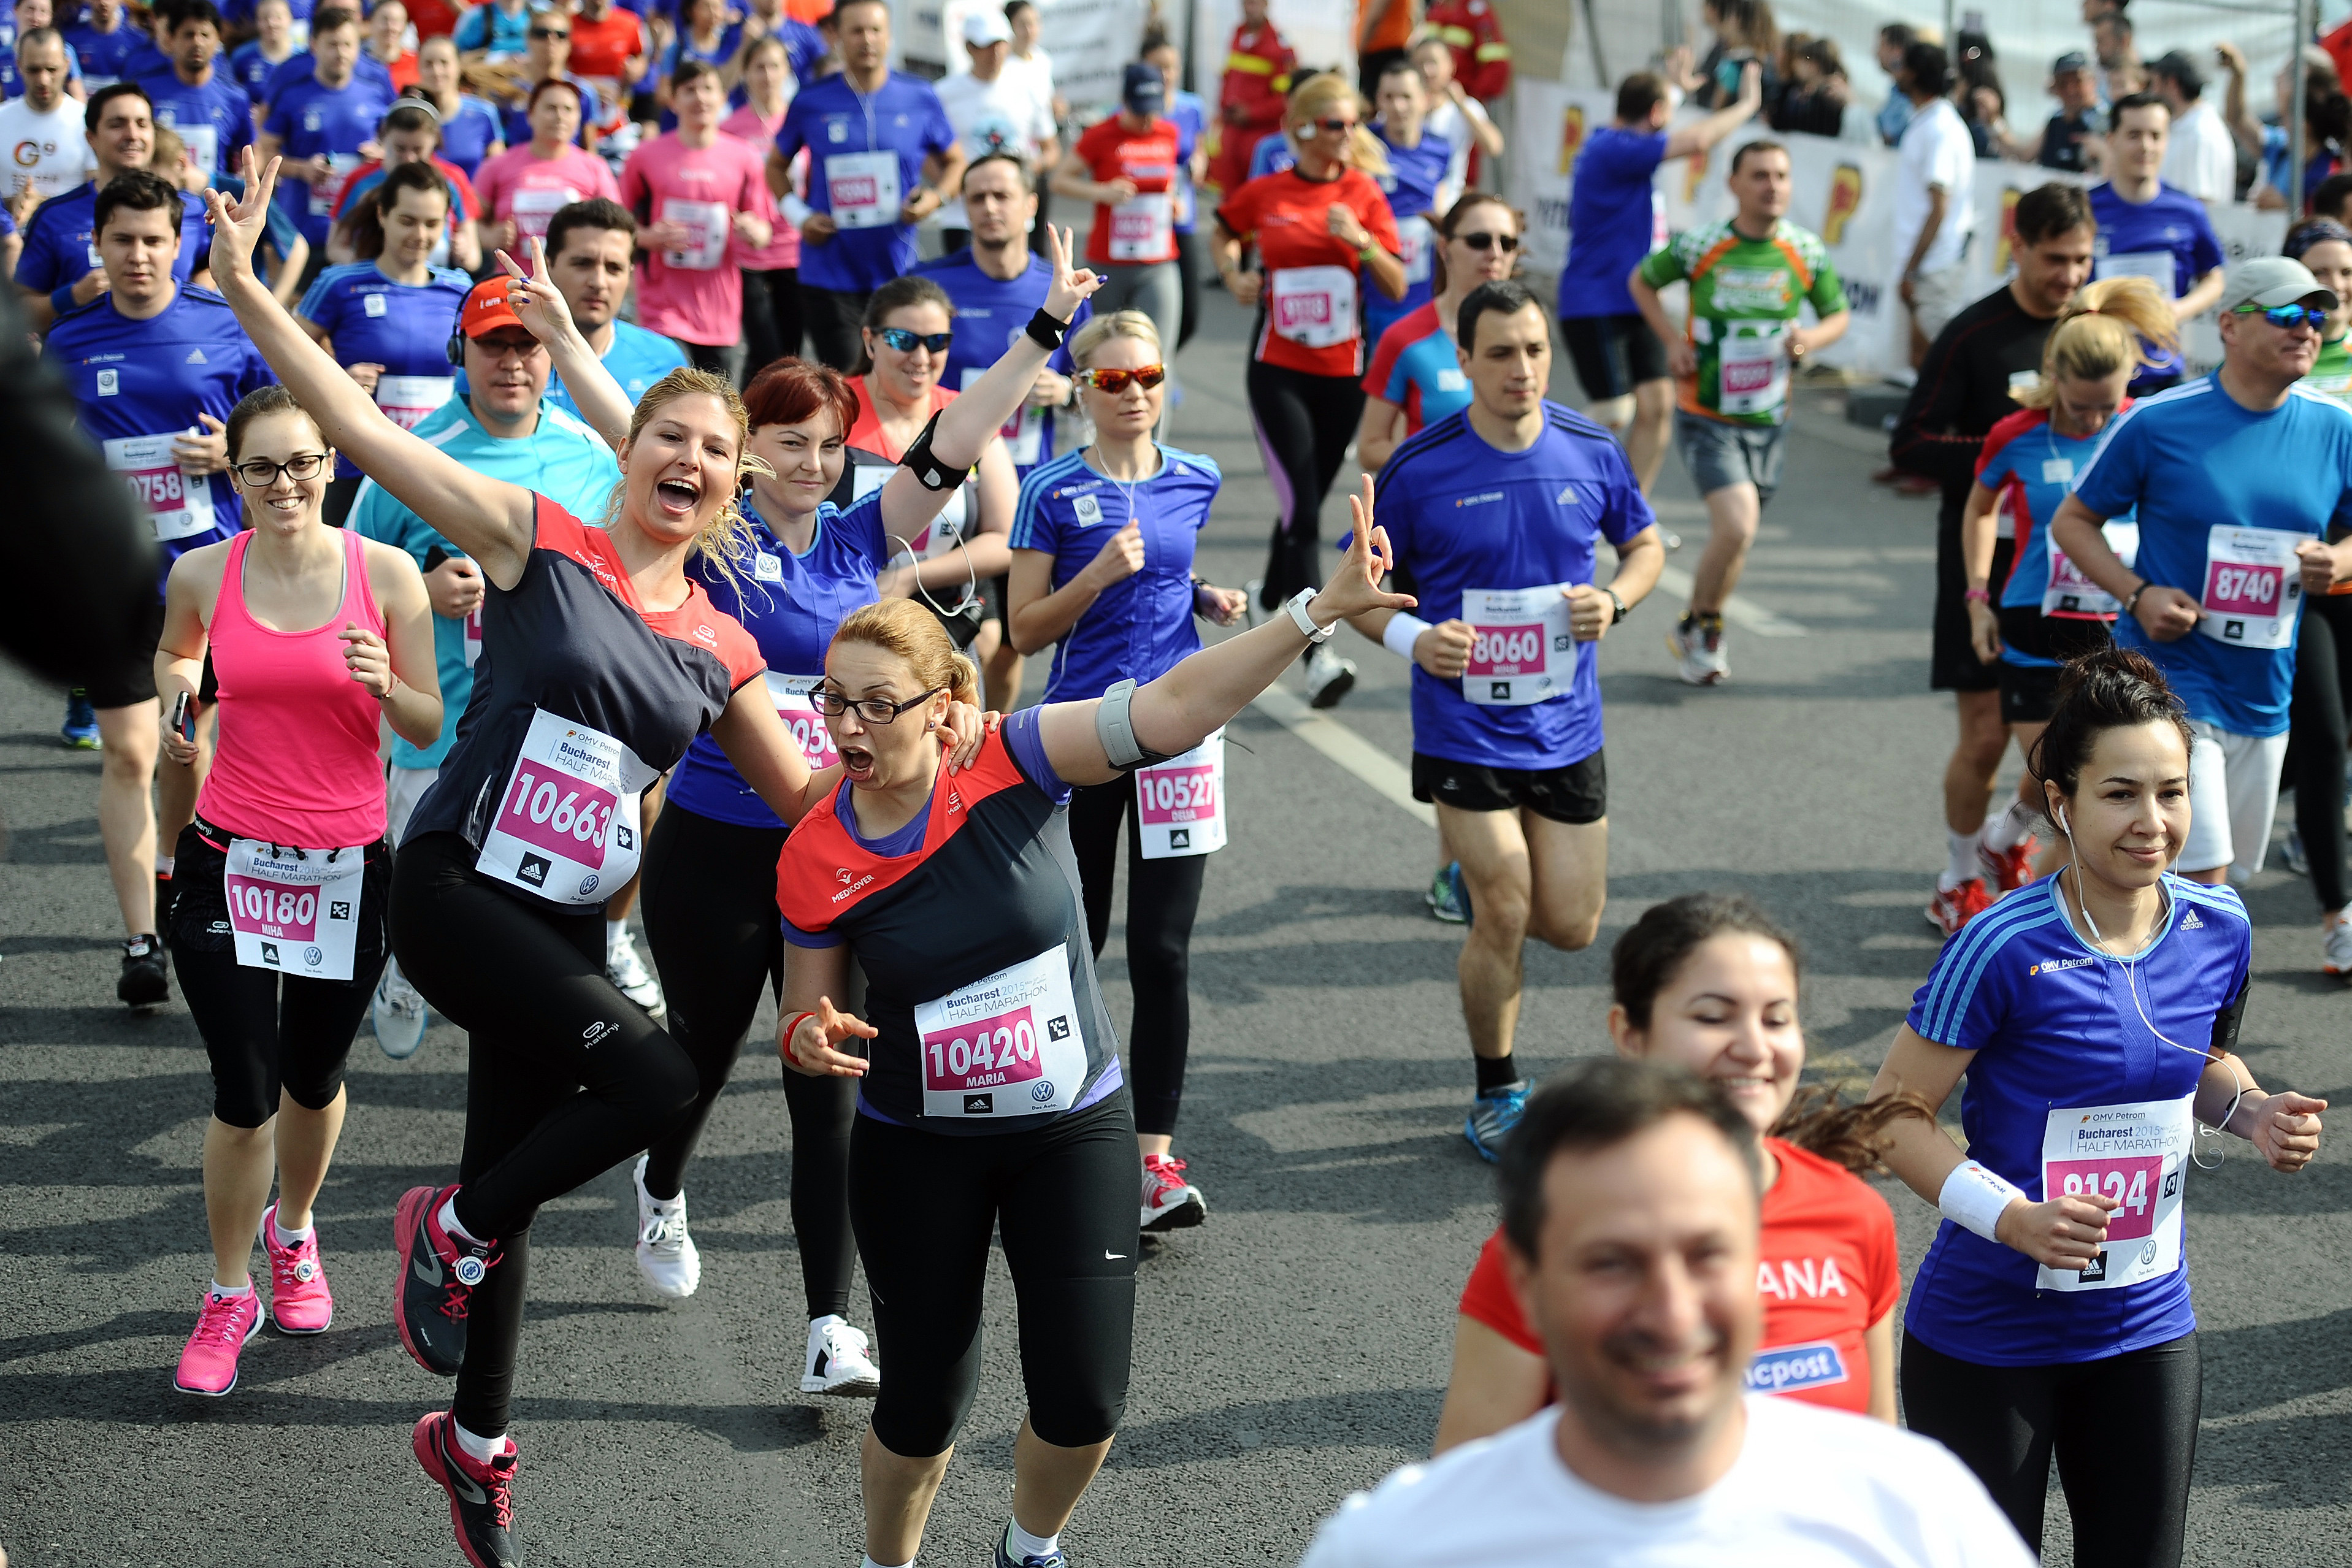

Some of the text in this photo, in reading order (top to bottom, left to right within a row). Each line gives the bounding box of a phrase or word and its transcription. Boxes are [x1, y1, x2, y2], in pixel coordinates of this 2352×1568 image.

[575, 550, 618, 583] MEDICOVER
[2215, 567, 2277, 605] 8740
[1473, 629, 1540, 664] 8060
[578, 733, 599, 746] OMV
[555, 752, 588, 774] HALF
[560, 741, 611, 770] Bucharest
[1142, 771, 1214, 811] 10527
[512, 773, 611, 849] 10663
[251, 866, 341, 882] HALF MARATHON
[253, 857, 298, 873] Bucharest
[521, 868, 542, 882] adidas
[831, 874, 875, 903] MEDICOVER
[231, 884, 316, 926] 10180
[261, 923, 284, 938] MIHA
[2180, 921, 2204, 931] adidas
[2041, 957, 2093, 971] OMV Petrom
[946, 981, 1025, 1009] Bucharest 2015
[949, 984, 1048, 1021] HALF MARATHON
[929, 1019, 1036, 1077] 10420
[966, 1071, 1006, 1088] MARIA
[2093, 1111, 2146, 1122] OMV Petrom
[2077, 1134, 2180, 1153] HALF MARATHON
[2078, 1126, 2133, 1140] Bucharest
[2135, 1125, 2160, 1137] 2015
[1757, 1257, 1848, 1300] ANA
